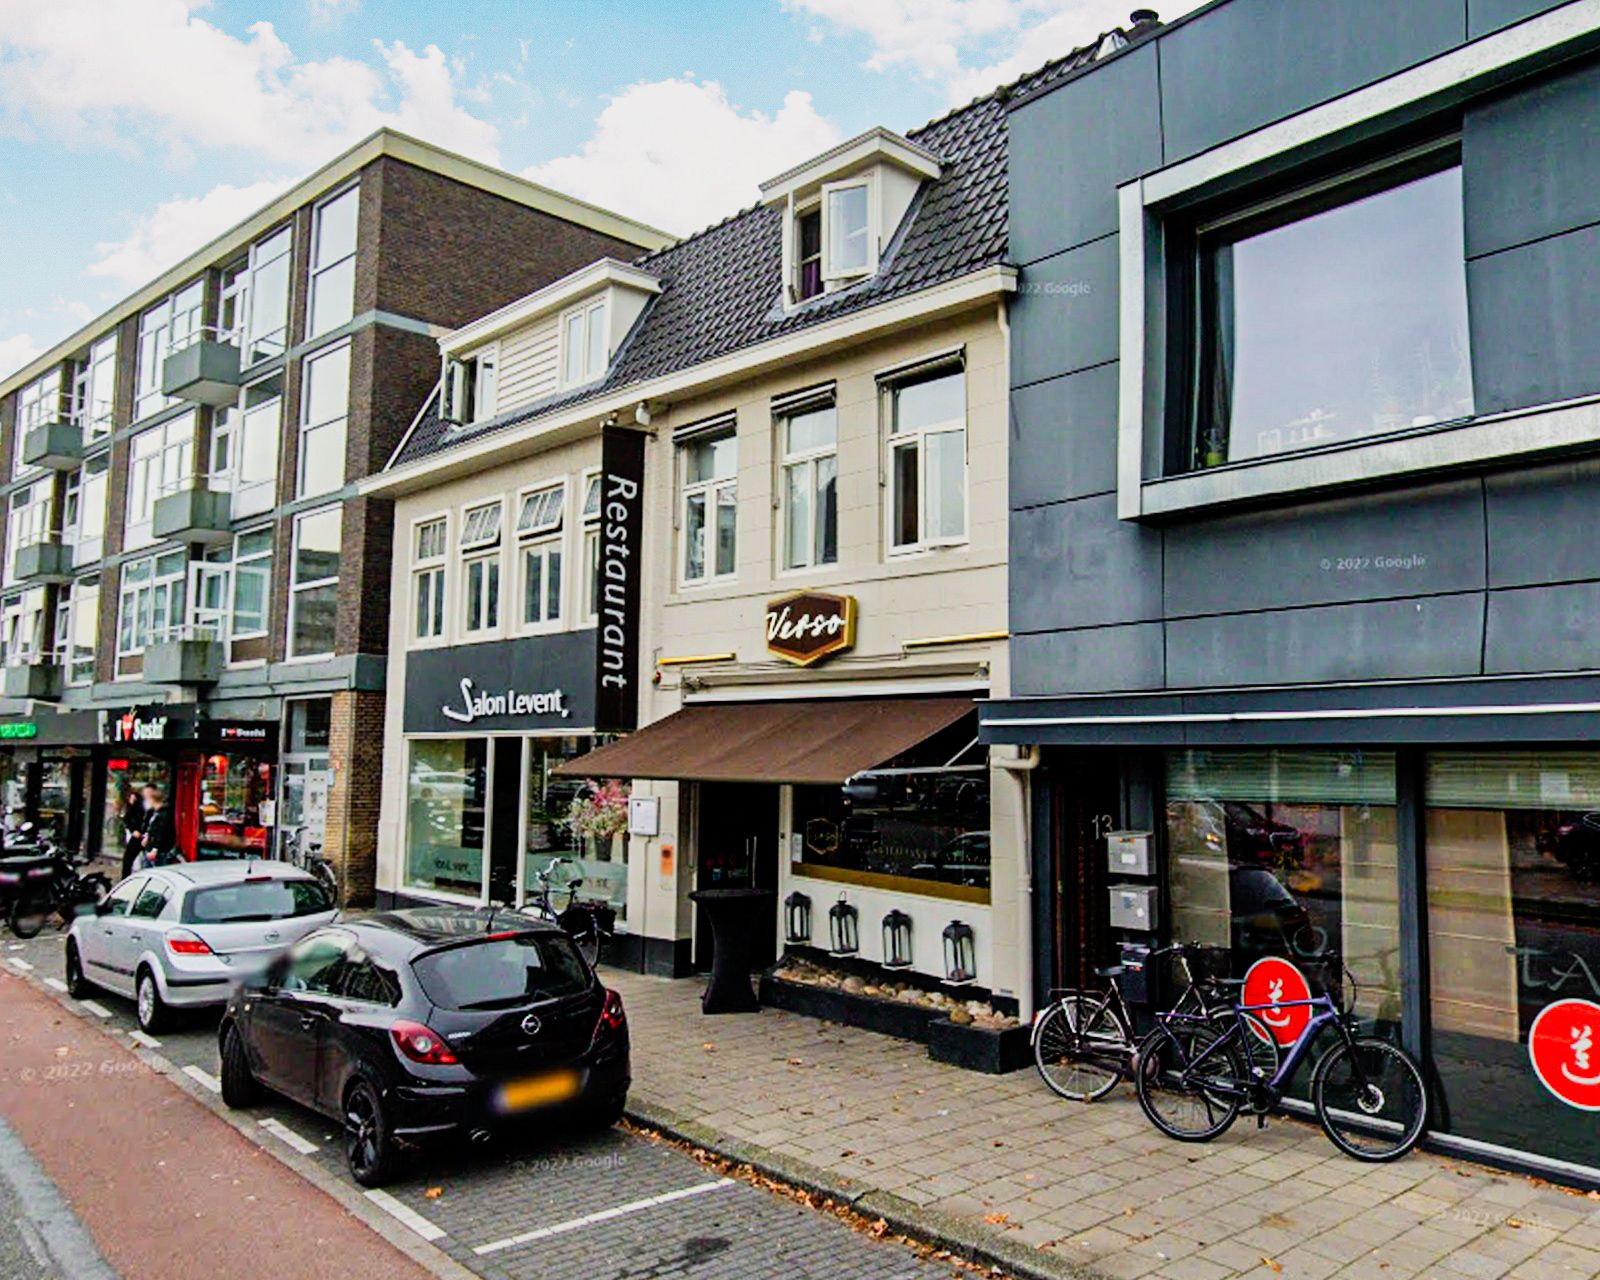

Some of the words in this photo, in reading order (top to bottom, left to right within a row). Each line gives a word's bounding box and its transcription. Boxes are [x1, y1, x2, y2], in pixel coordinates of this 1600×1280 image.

[602, 473, 638, 689] Restaurant
[765, 606, 848, 640] Verso
[442, 677, 506, 722] Salon
[133, 715, 167, 741] Sushi
[1091, 814, 1114, 841] 13
